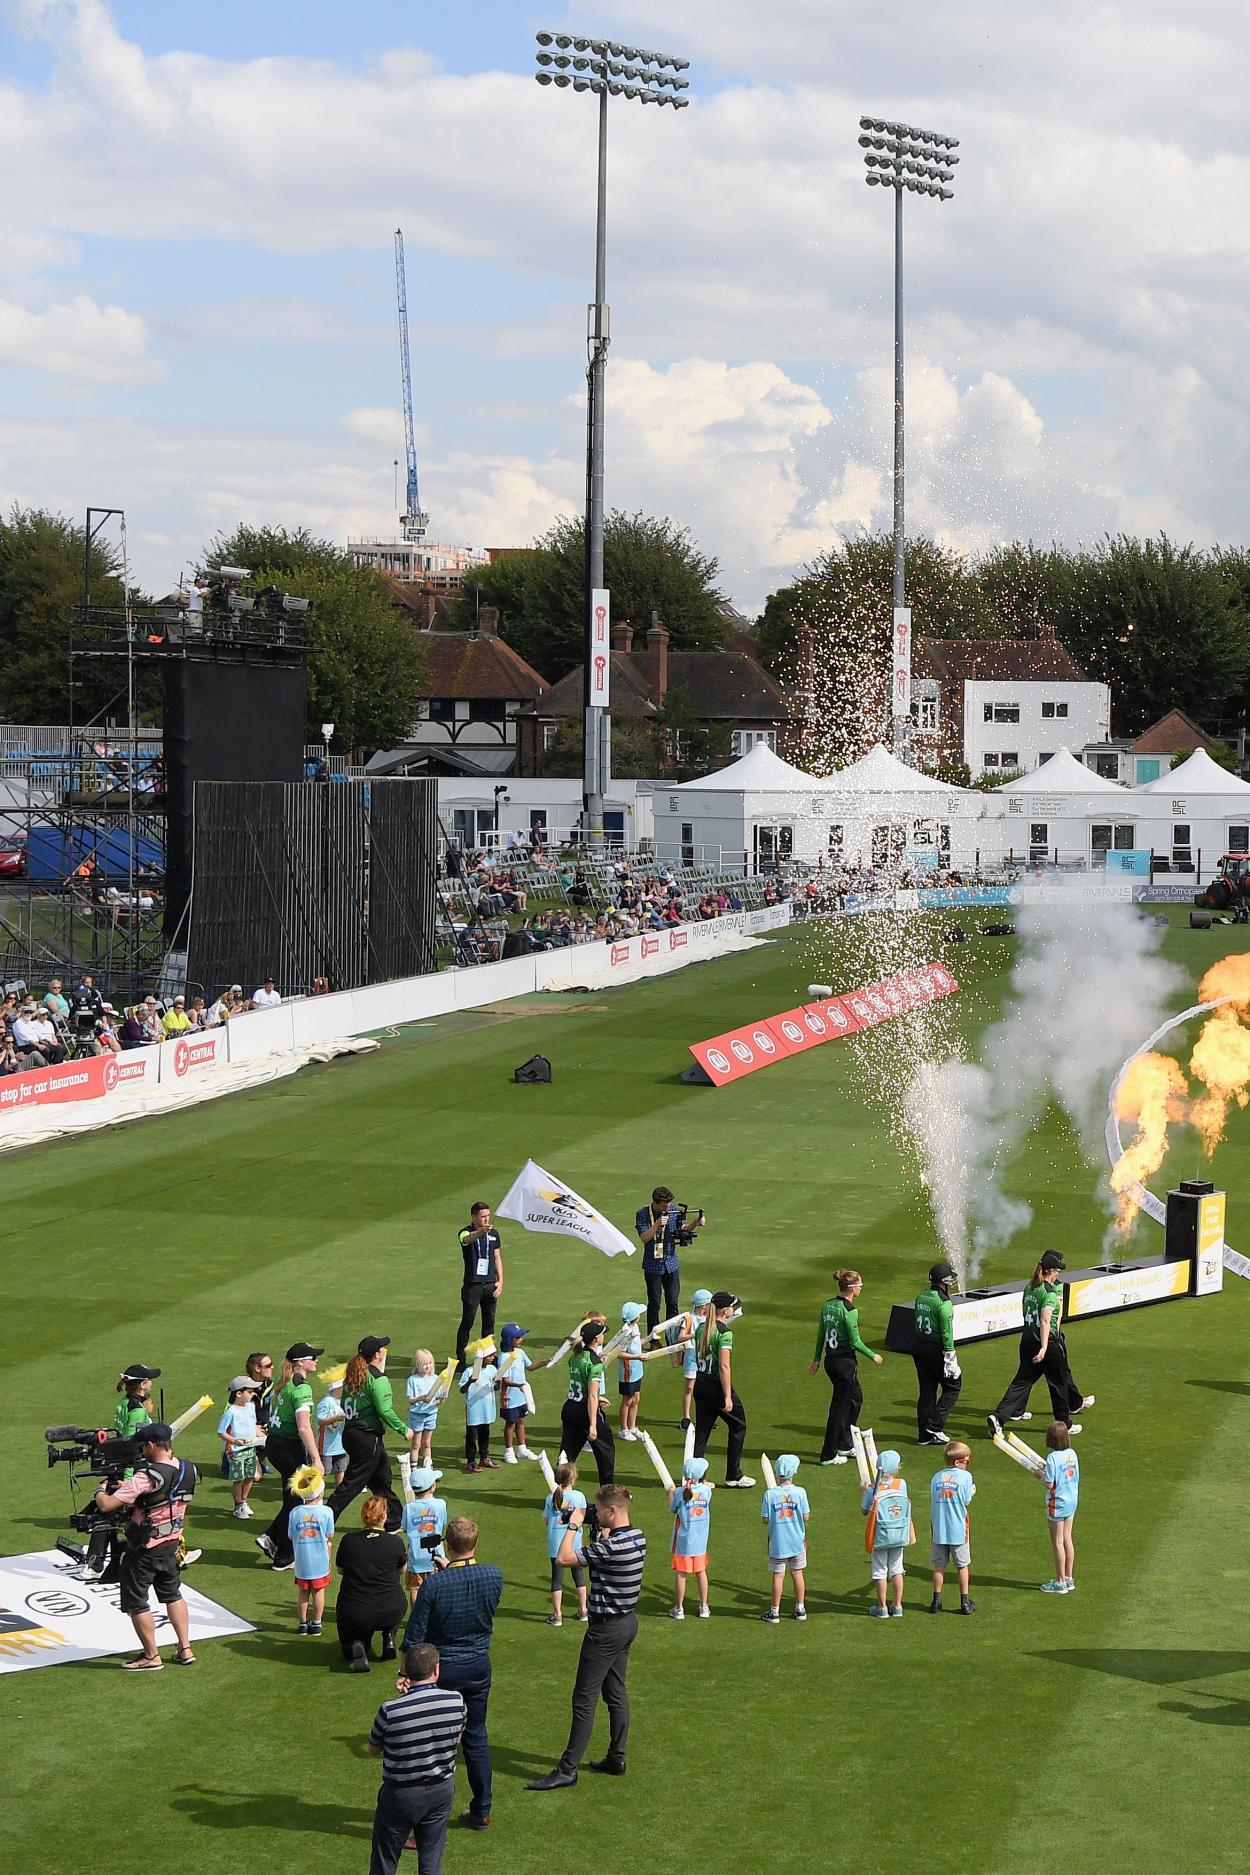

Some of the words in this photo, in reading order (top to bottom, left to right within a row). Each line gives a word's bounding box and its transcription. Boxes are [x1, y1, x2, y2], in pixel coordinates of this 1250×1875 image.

[1148, 887, 1170, 896] Spring
[1171, 886, 1207, 896] Orthopaed
[190, 1047, 214, 1061] CENTRAL
[119, 1065, 144, 1078] CENTRAL
[1, 1085, 18, 1102] stop
[20, 1083, 32, 1101] for
[34, 1080, 47, 1094] car
[49, 1072, 88, 1090] insurance
[555, 1208, 573, 1218] KIA
[526, 1213, 554, 1225] SUPER
[556, 1219, 593, 1236] LEAGUE
[568, 1379, 584, 1402] 53
[35, 1593, 78, 1615] KIA
